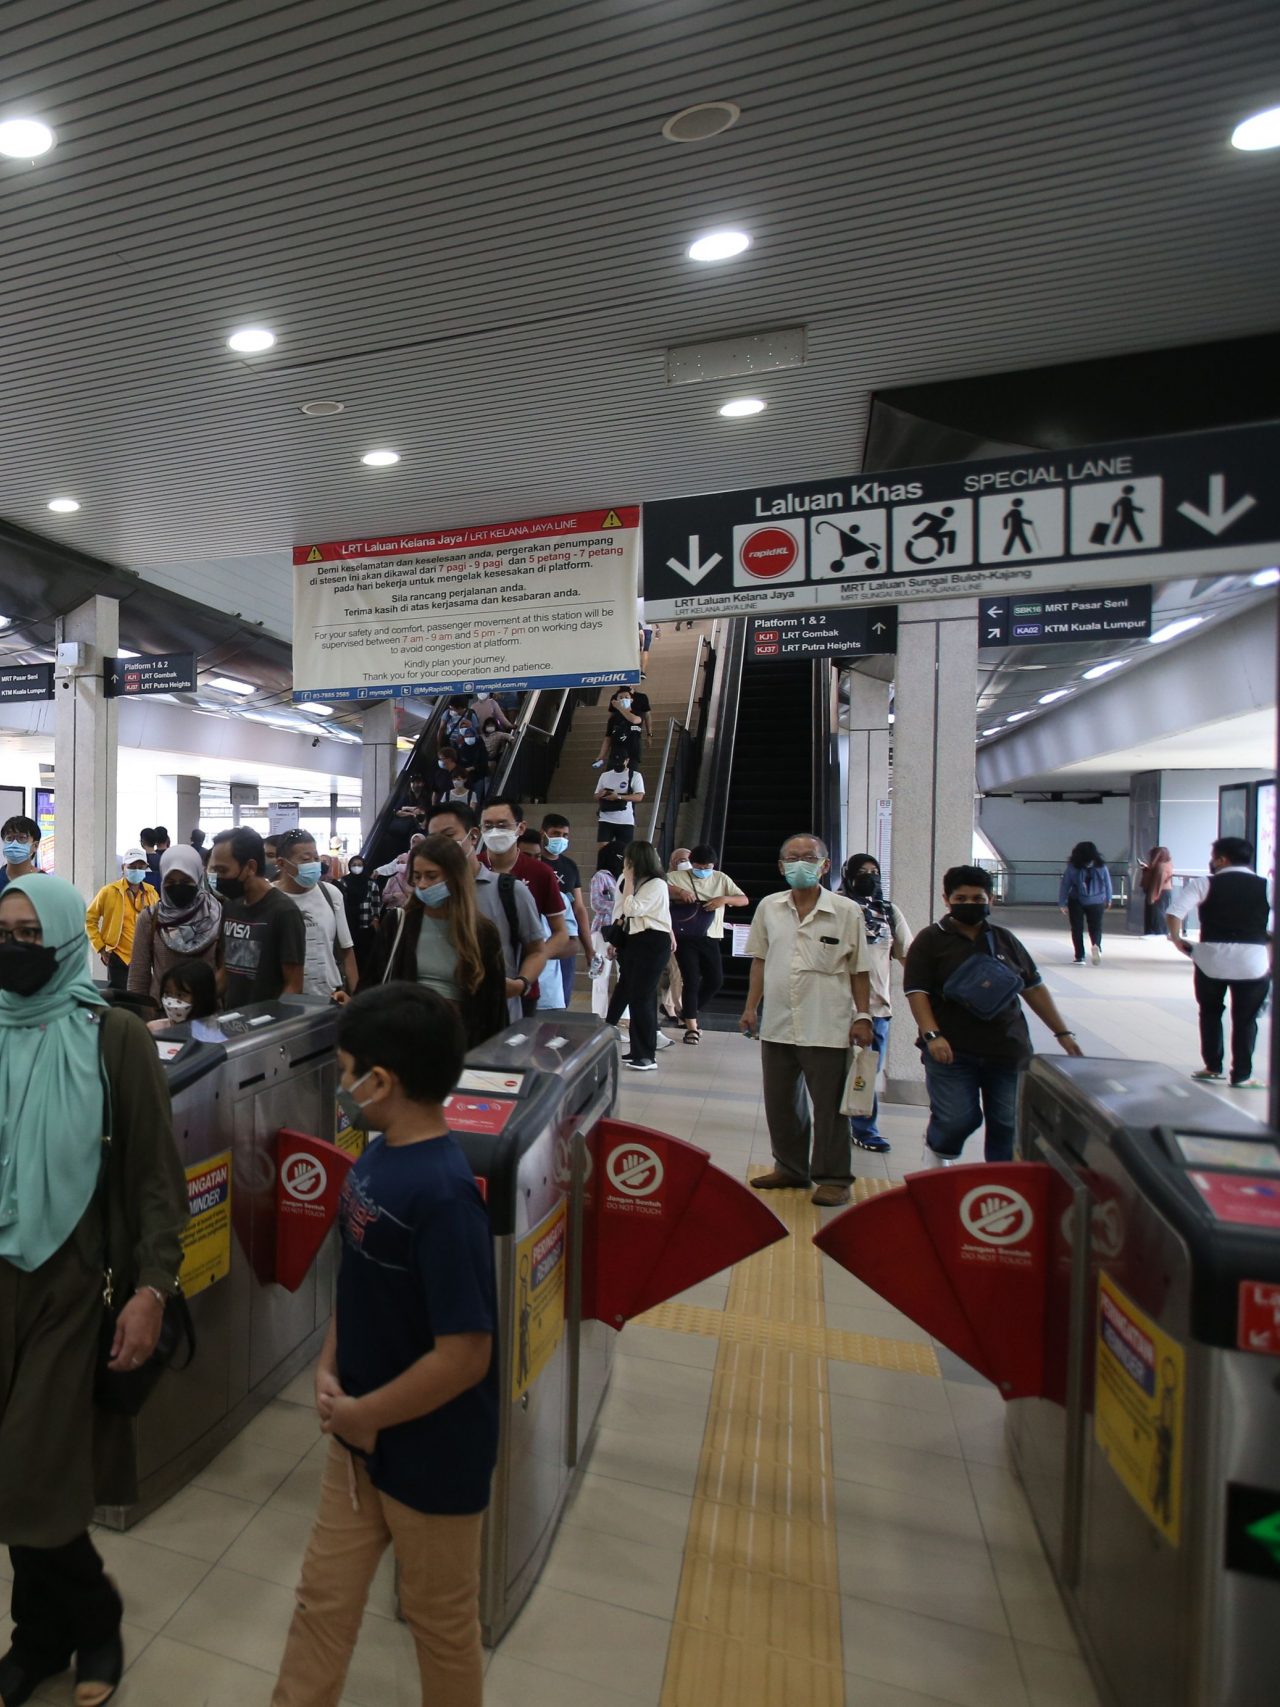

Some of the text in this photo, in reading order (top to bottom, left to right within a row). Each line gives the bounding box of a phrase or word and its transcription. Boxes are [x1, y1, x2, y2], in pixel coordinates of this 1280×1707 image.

[963, 457, 1133, 492] SPECIAL LANE
[755, 481, 924, 517] Laluan Khas
[342, 520, 577, 555] LRT Laluan Kelana Jaya LRT KELANA JAYA LINE
[318, 537, 614, 575] Demi keselamatan keselesaan pergerakan penumpang
[748, 546, 789, 559] rapidKL
[320, 547, 624, 585] stesen akan dikawal pagi pagi dan petang petang
[334, 560, 593, 594] pada bekerja untuk mengelak kesesakan platform.
[841, 568, 1032, 593] MRT Laluan Sungai Buloh-Kajang
[960, 582, 983, 591] LINE
[344, 589, 581, 617] Terima kasih atas kerjasama dan kesabaran anda.
[392, 584, 526, 603] Sila rancang perjalanan anda.
[674, 589, 795, 608] LRT Laluan Kelana Jaya
[675, 603, 757, 616] LRT KELANA LINE
[1015, 599, 1128, 615] SBK16 MRT Pasar Seni
[348, 608, 614, 639] safety passenger movement station will be
[755, 619, 797, 628] Platform
[1016, 619, 1146, 634] KA02 KTM Kuala Lumpur
[322, 621, 603, 651] supervised between and working days
[400, 641, 471, 653] avoid congestion
[827, 642, 861, 650] Heights
[363, 661, 553, 681] Thank cooperation and patience.
[404, 657, 450, 669] Kindly plan
[413, 672, 627, 695] @MyRapidKL myrapid.com.my rapidKL
[224, 921, 250, 939] NASA
[606, 1202, 662, 1215] DO NOT TOUCH
[607, 1195, 662, 1208] Jangan Sentuh
